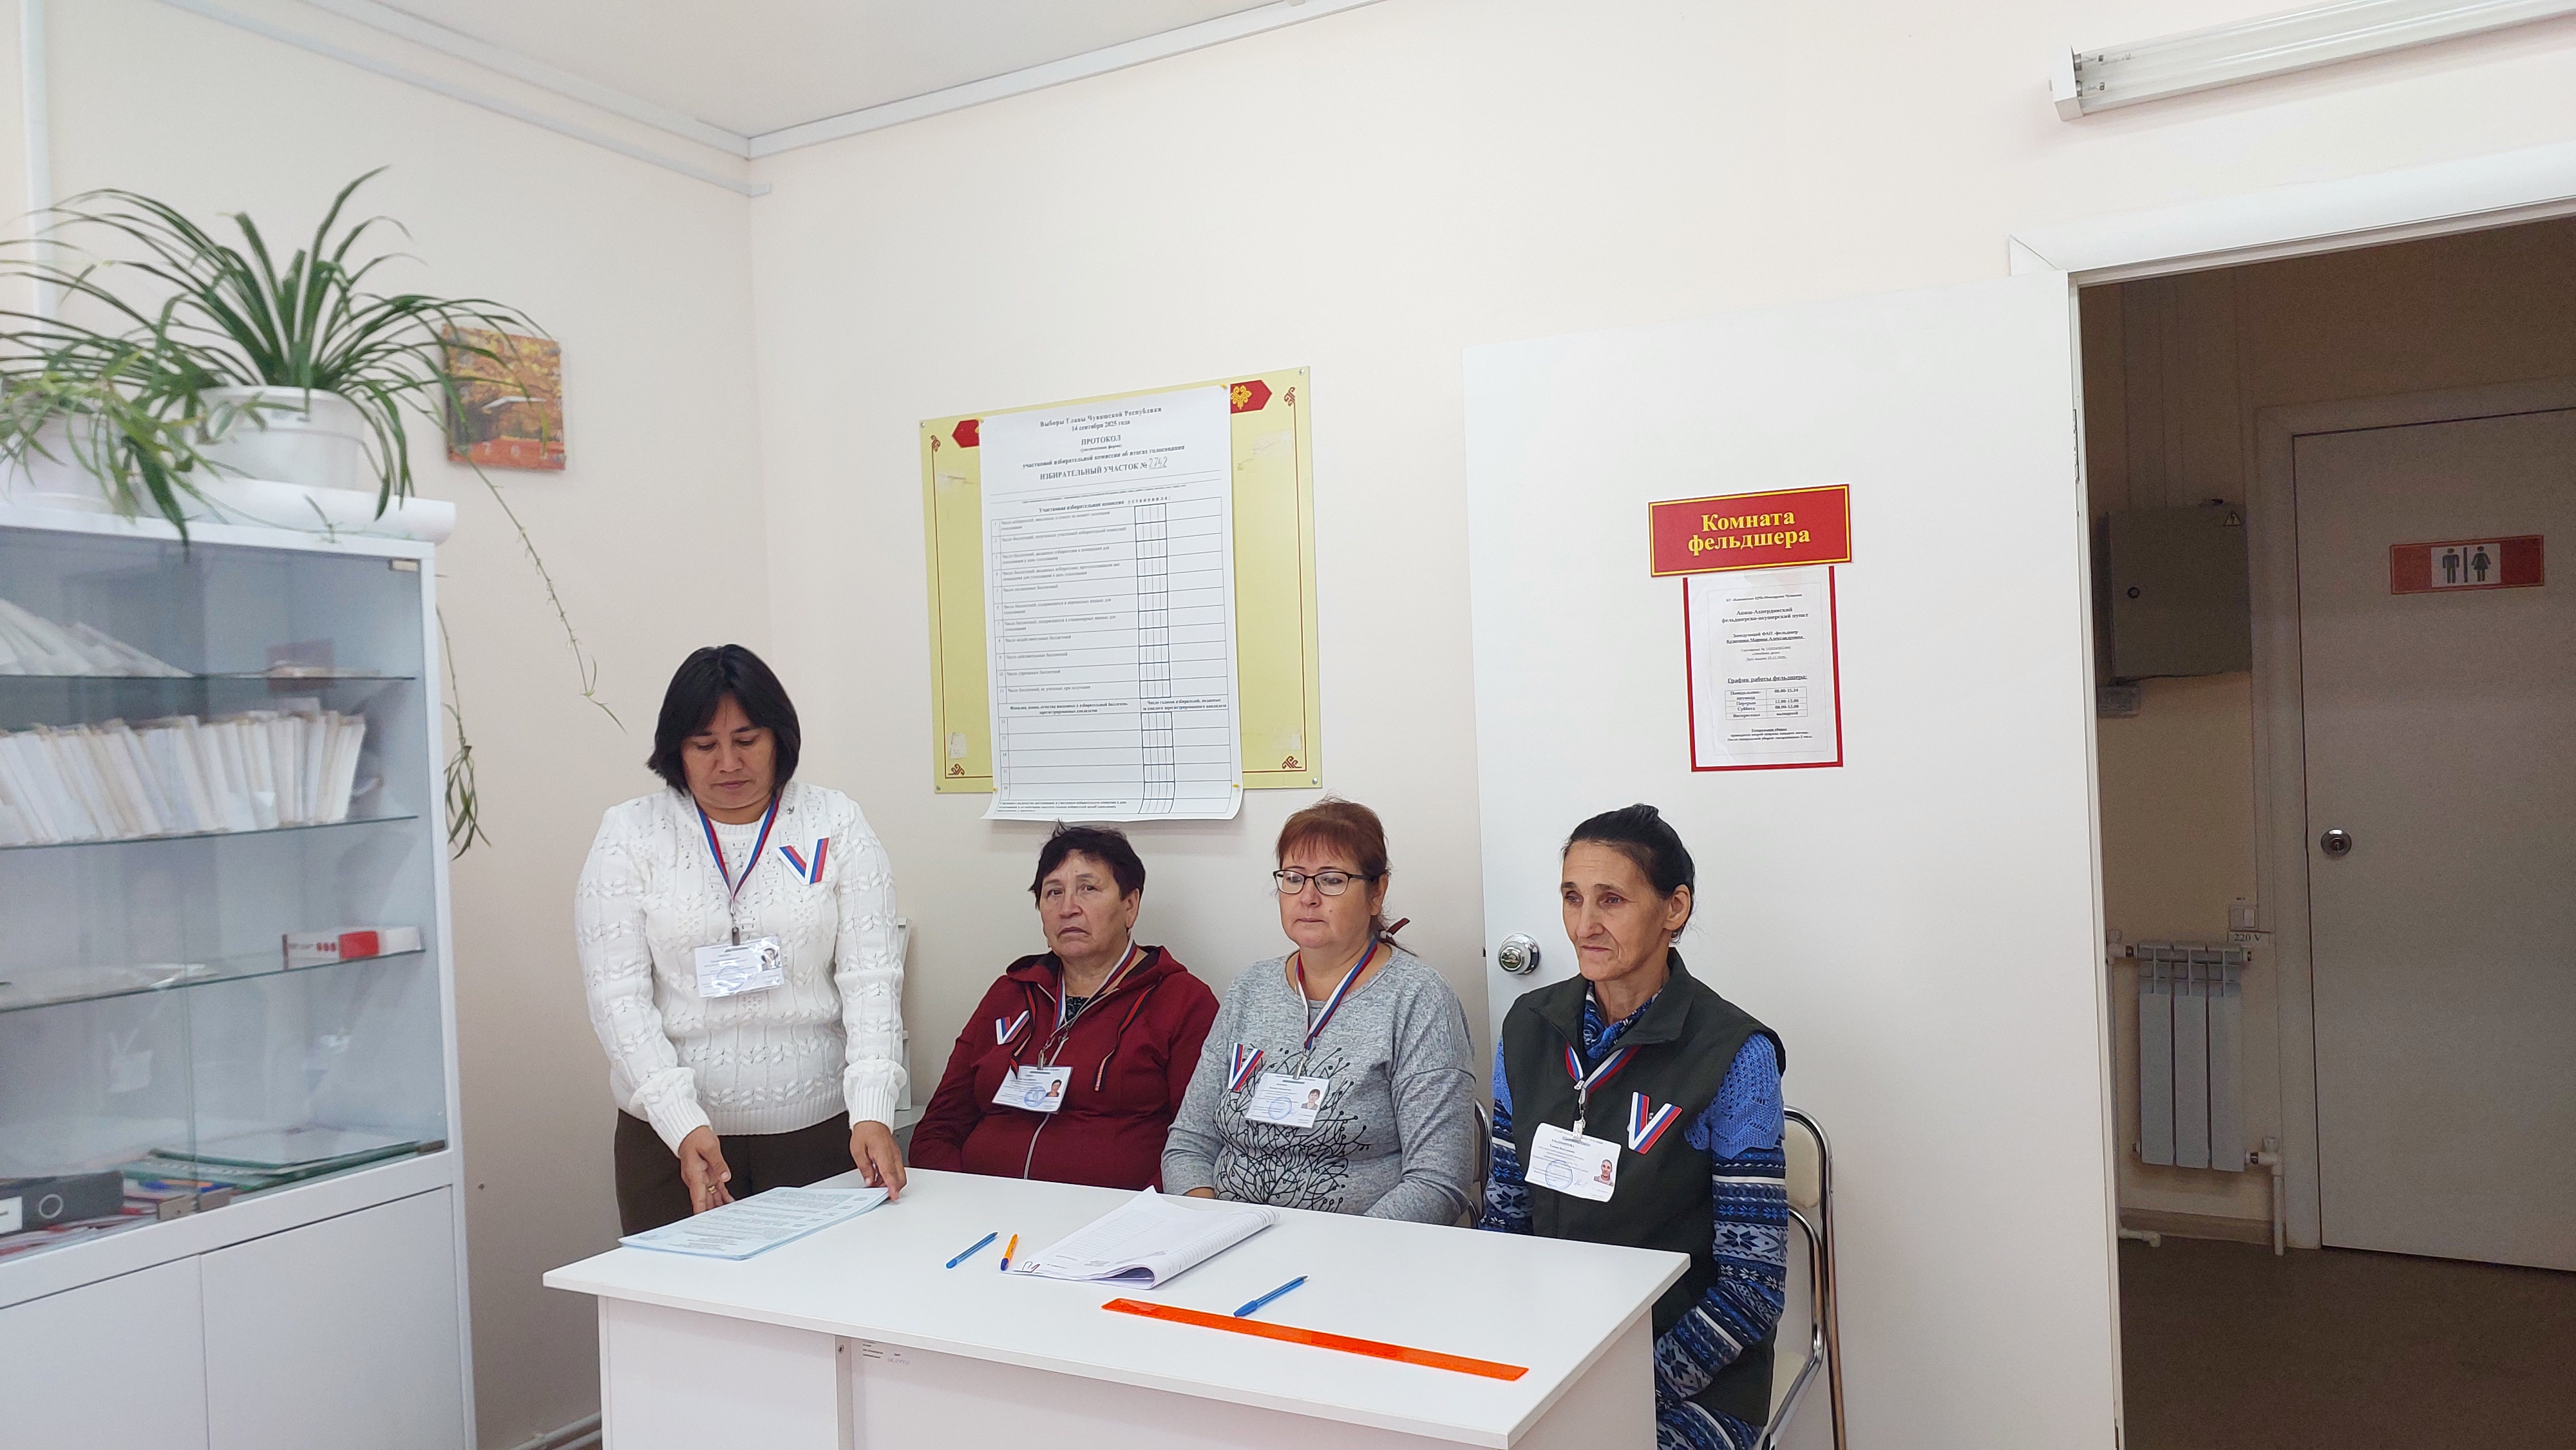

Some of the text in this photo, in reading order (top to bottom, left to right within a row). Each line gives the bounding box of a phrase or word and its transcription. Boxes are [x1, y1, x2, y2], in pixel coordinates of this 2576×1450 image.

[1040, 419, 1064, 428] Выборы
[1088, 412, 1122, 422] Чувашской
[1124, 407, 1162, 417] Республики
[1081, 435, 1121, 446] ПРОТОКОЛ
[1023, 460, 1052, 469] участковой
[1054, 455, 1093, 465] избирательной
[1149, 445, 1184, 453] голосования
[1149, 457, 1168, 468] 2742
[1040, 466, 1102, 480] ИЗБИРАТЕЛЬНЫЙ
[1104, 463, 1139, 474] УЧАСТОК
[1701, 511, 1795, 532] Комната
[1687, 529, 1810, 556] фельдшера
